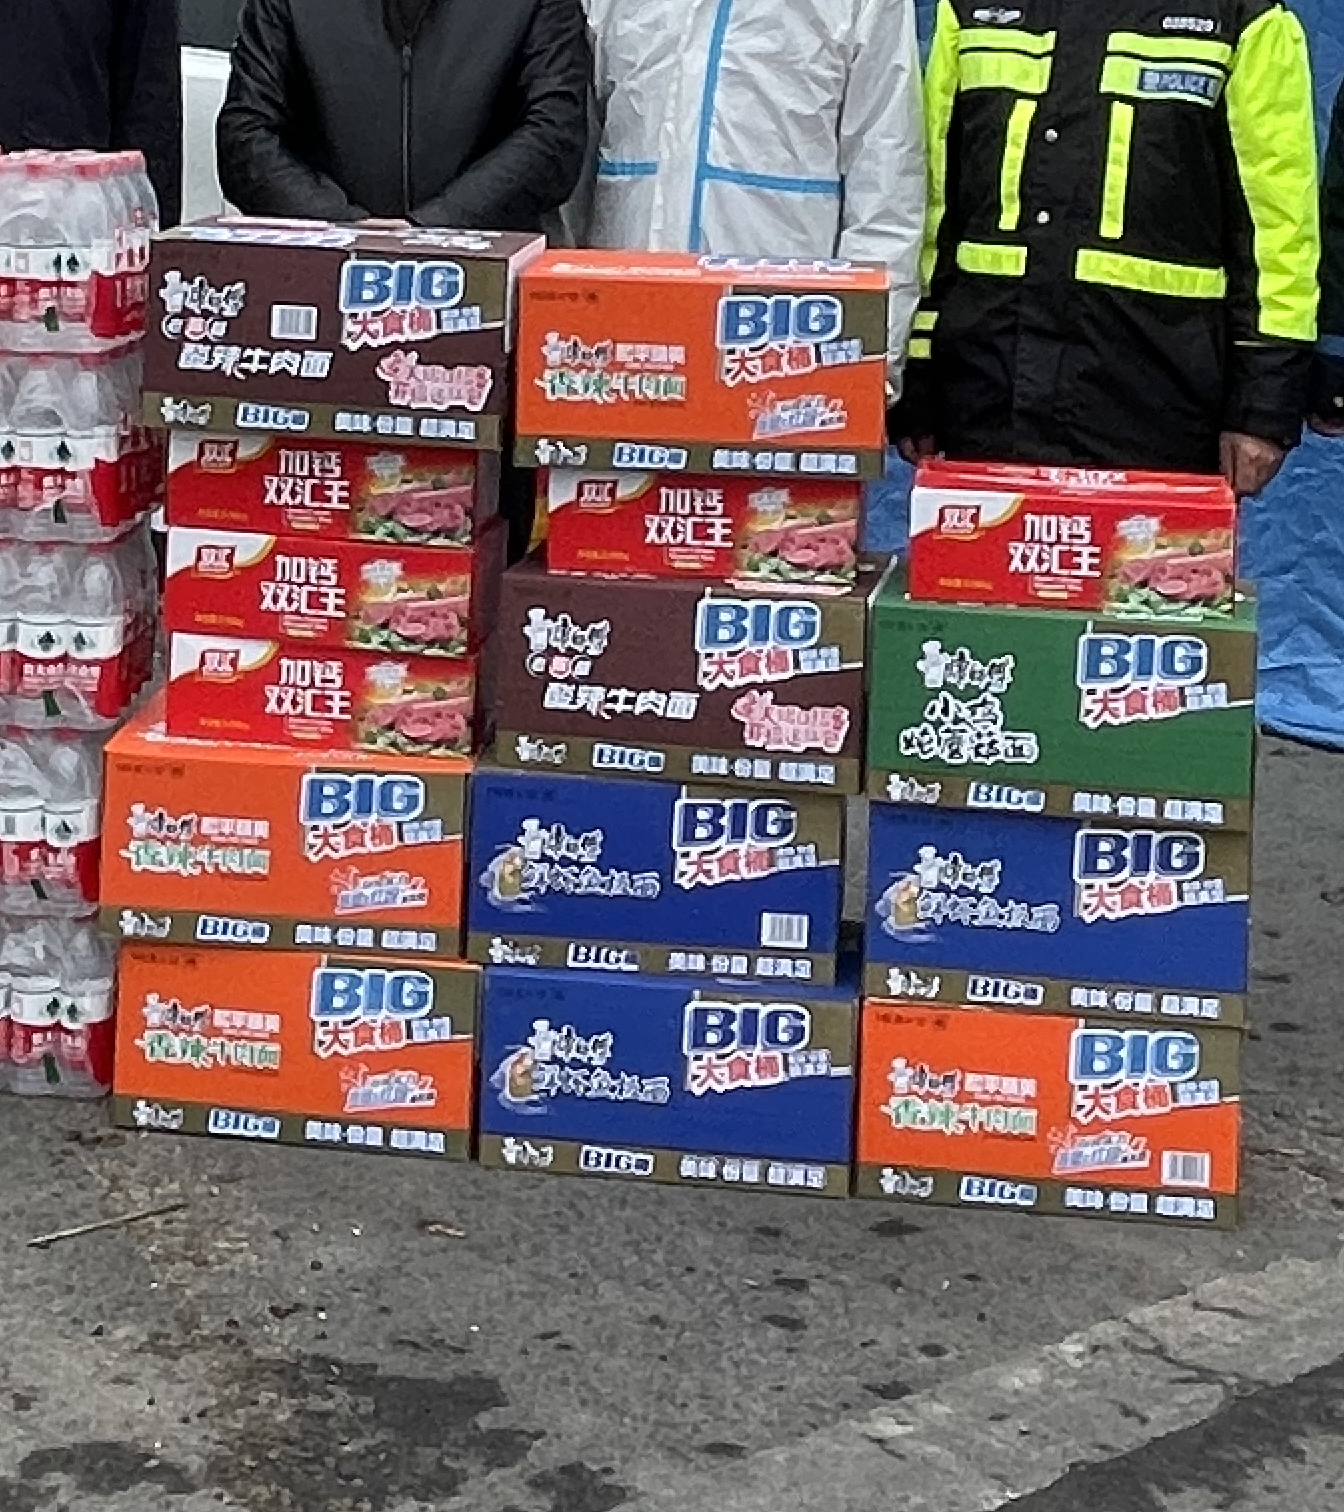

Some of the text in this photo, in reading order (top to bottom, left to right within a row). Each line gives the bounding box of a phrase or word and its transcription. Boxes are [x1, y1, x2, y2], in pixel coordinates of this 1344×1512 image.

[346, 262, 463, 308] BIG
[721, 299, 841, 345] BIG
[263, 475, 351, 509] 双汇王
[644, 515, 733, 547] 双汇王
[1008, 542, 1101, 577] 双汇王
[260, 580, 345, 617] 双汇王
[699, 602, 819, 650] BIG
[1080, 636, 1206, 686] BIG
[265, 685, 351, 719] 双汇王
[304, 776, 424, 823] BIG
[675, 801, 797, 848] BIG
[1077, 831, 1205, 880] BIG
[314, 970, 433, 1020] BIG
[684, 1003, 810, 1053] BIG
[1071, 1031, 1200, 1080] BIG
